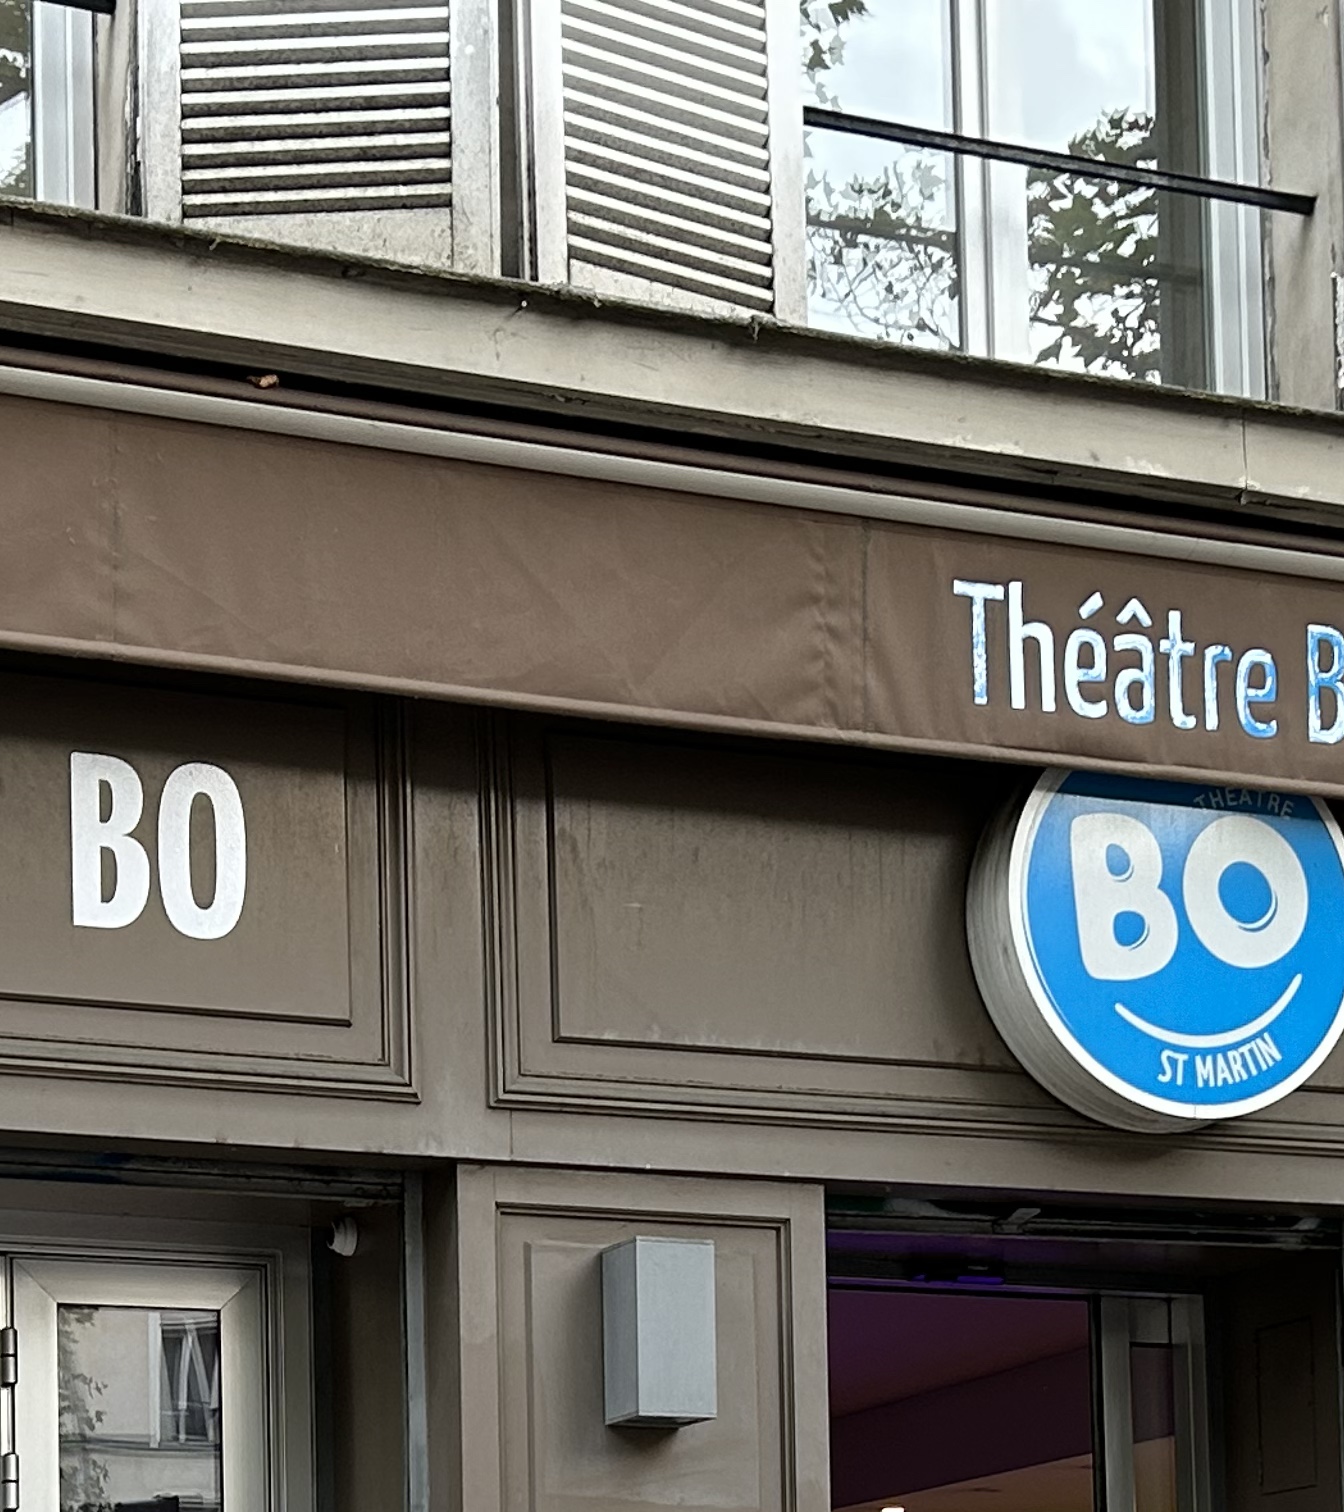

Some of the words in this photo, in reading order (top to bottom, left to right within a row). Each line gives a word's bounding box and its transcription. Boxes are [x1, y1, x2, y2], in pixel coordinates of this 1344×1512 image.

[953, 579, 1278, 739] Théâtre
[70, 750, 248, 941] BO
[1069, 811, 1310, 982] BO
[1157, 1048, 1190, 1087] ST
[1195, 1033, 1283, 1088] MARTIN
